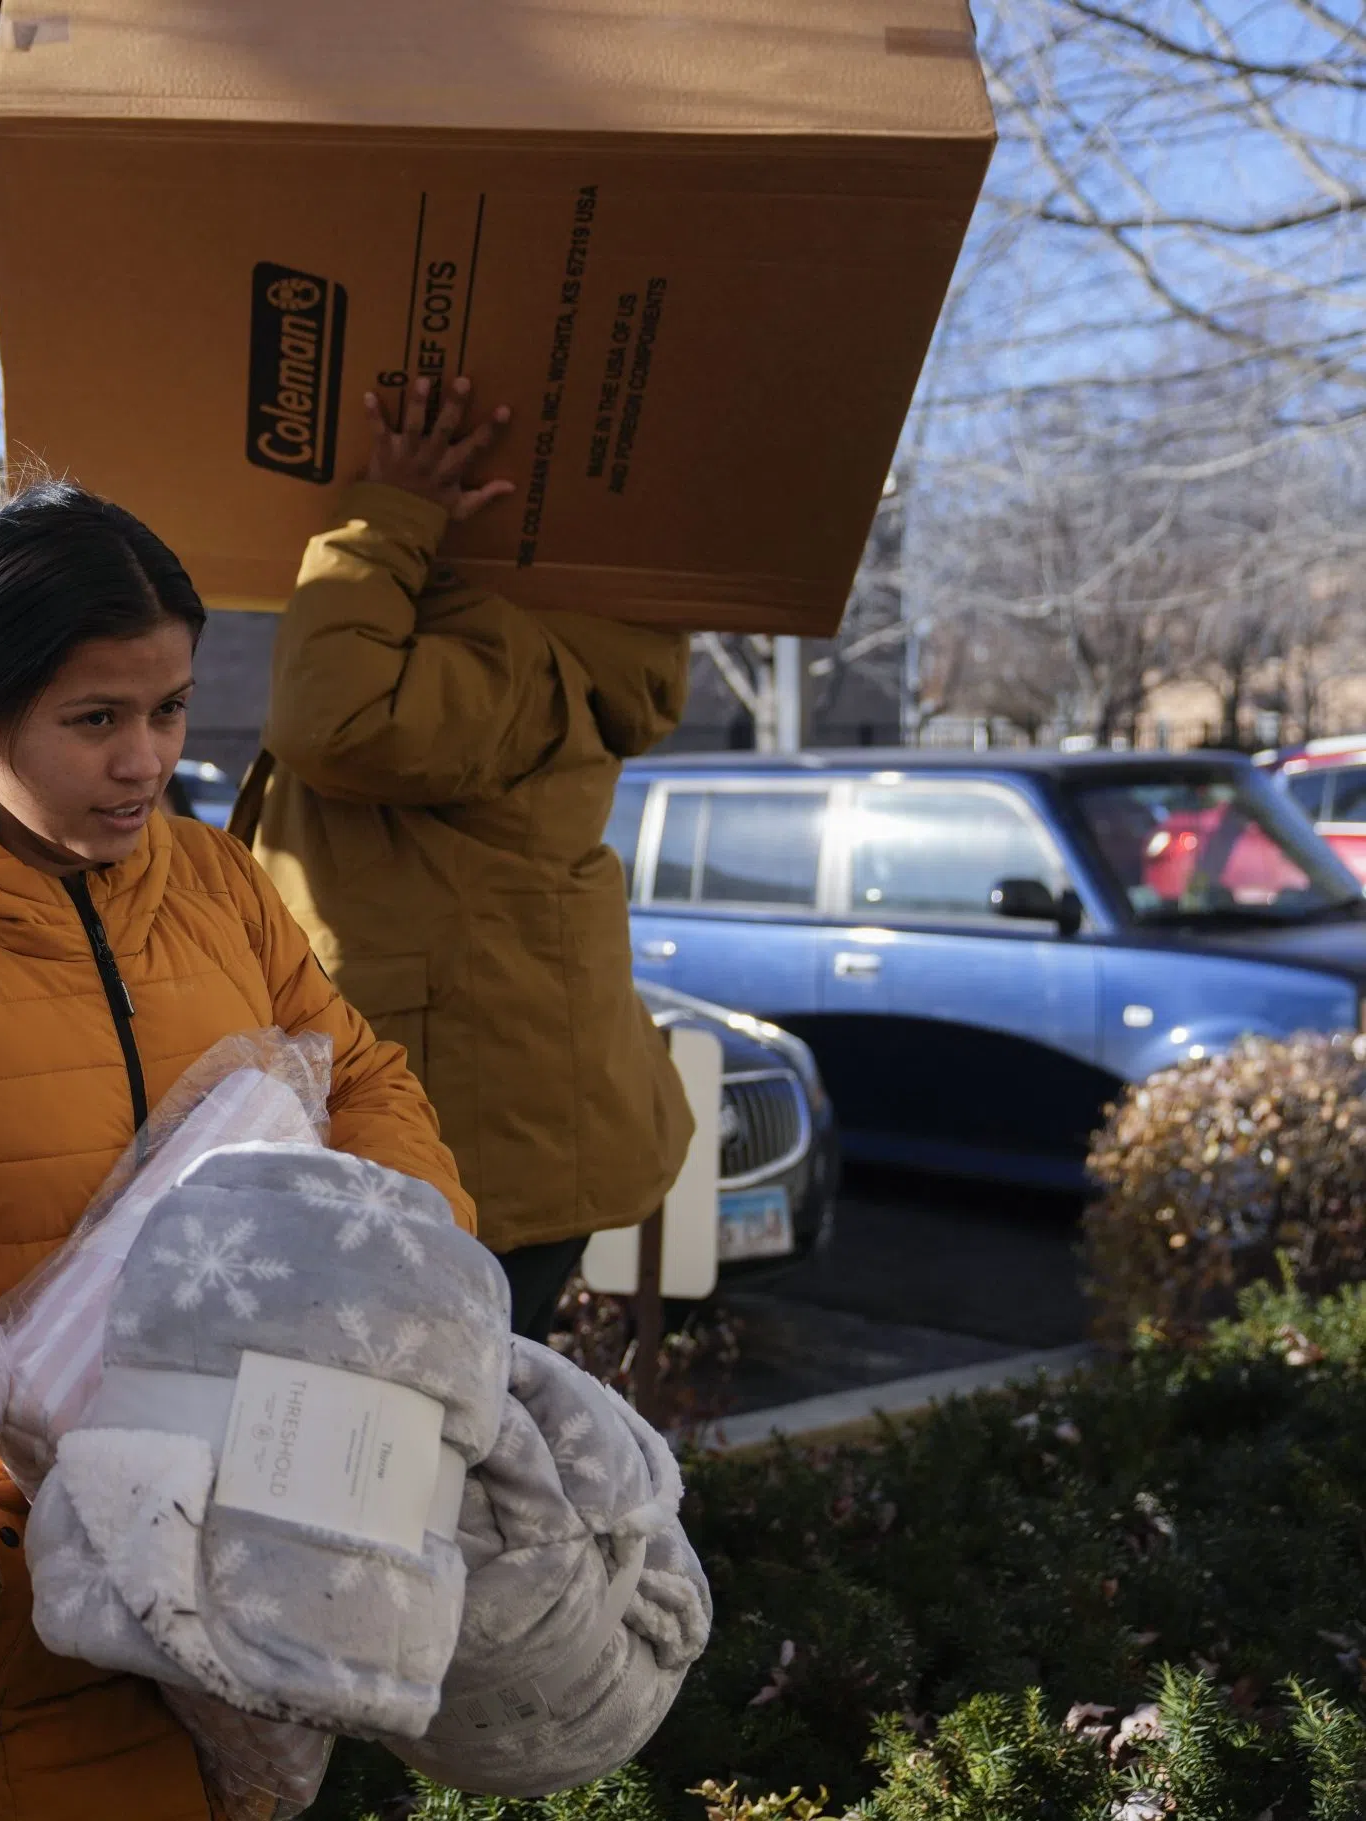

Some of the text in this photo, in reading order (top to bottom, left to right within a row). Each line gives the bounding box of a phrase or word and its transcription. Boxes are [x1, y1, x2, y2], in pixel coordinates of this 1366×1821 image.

[574, 185, 599, 223] USA
[565, 227, 590, 277] 67219
[421, 260, 457, 333] COTS
[560, 280, 581, 305] KS
[628, 276, 667, 391] COMPONENTS
[256, 314, 318, 465] Coleman
[376, 368, 408, 389] 6
[587, 292, 637, 477] MADE IN THE USA OF US
[615, 395, 642, 459] FOREIGN
[522, 460, 548, 535] COLEMAN
[269, 1379, 307, 1497] THRESHOLD
[377, 1440, 394, 1480] Throw
